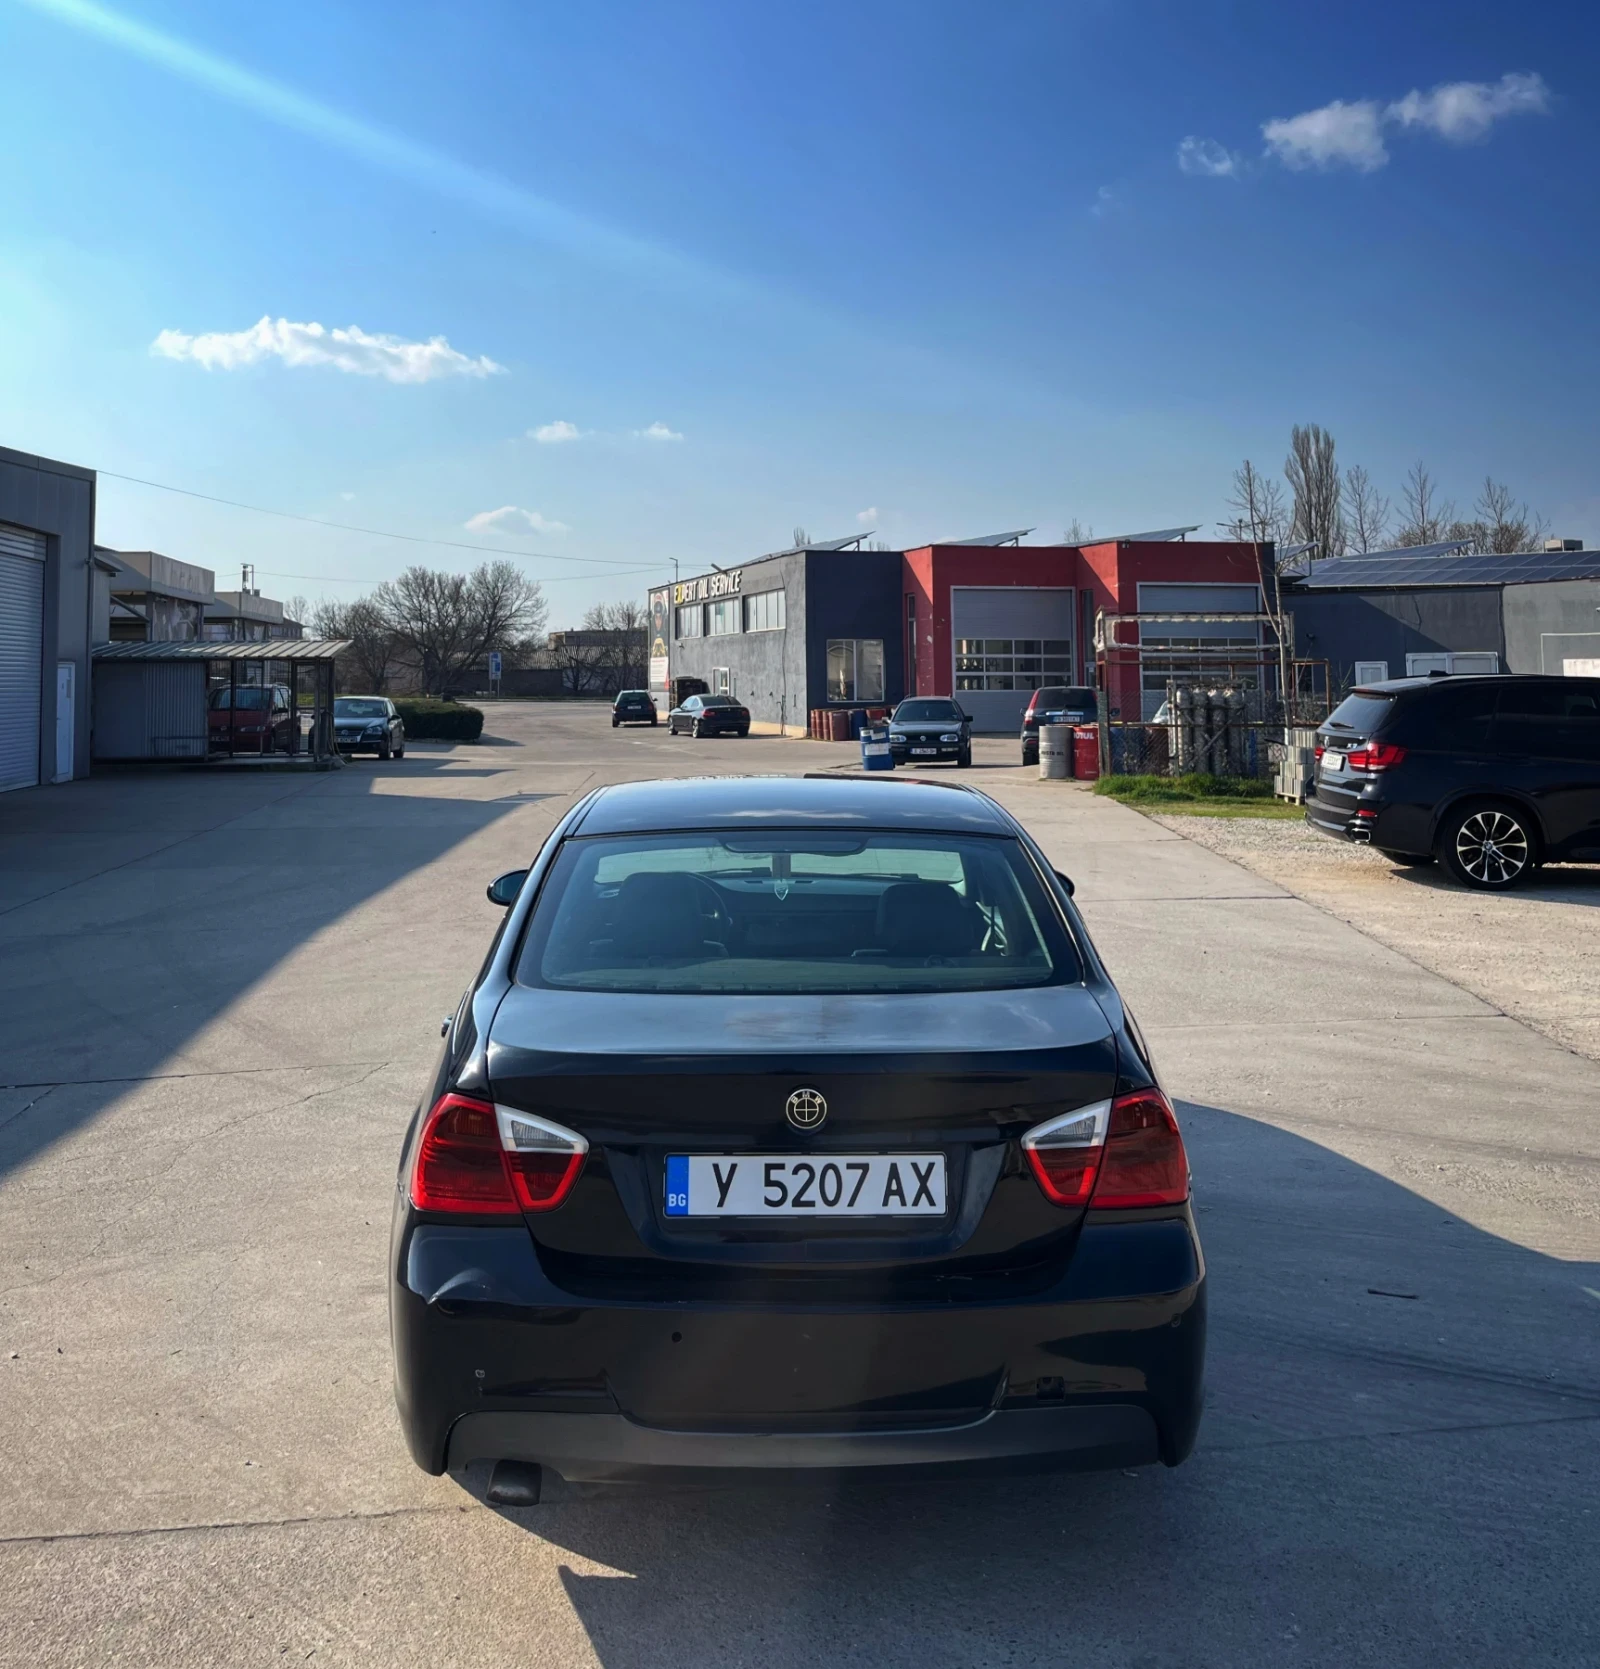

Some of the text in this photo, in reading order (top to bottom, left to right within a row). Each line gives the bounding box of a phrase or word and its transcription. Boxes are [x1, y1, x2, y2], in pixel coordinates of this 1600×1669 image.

[674, 570, 742, 604] EXPERT OIL SERVICE
[668, 1193, 687, 1207] BG
[712, 1162, 937, 1208] Y 5207 AX
